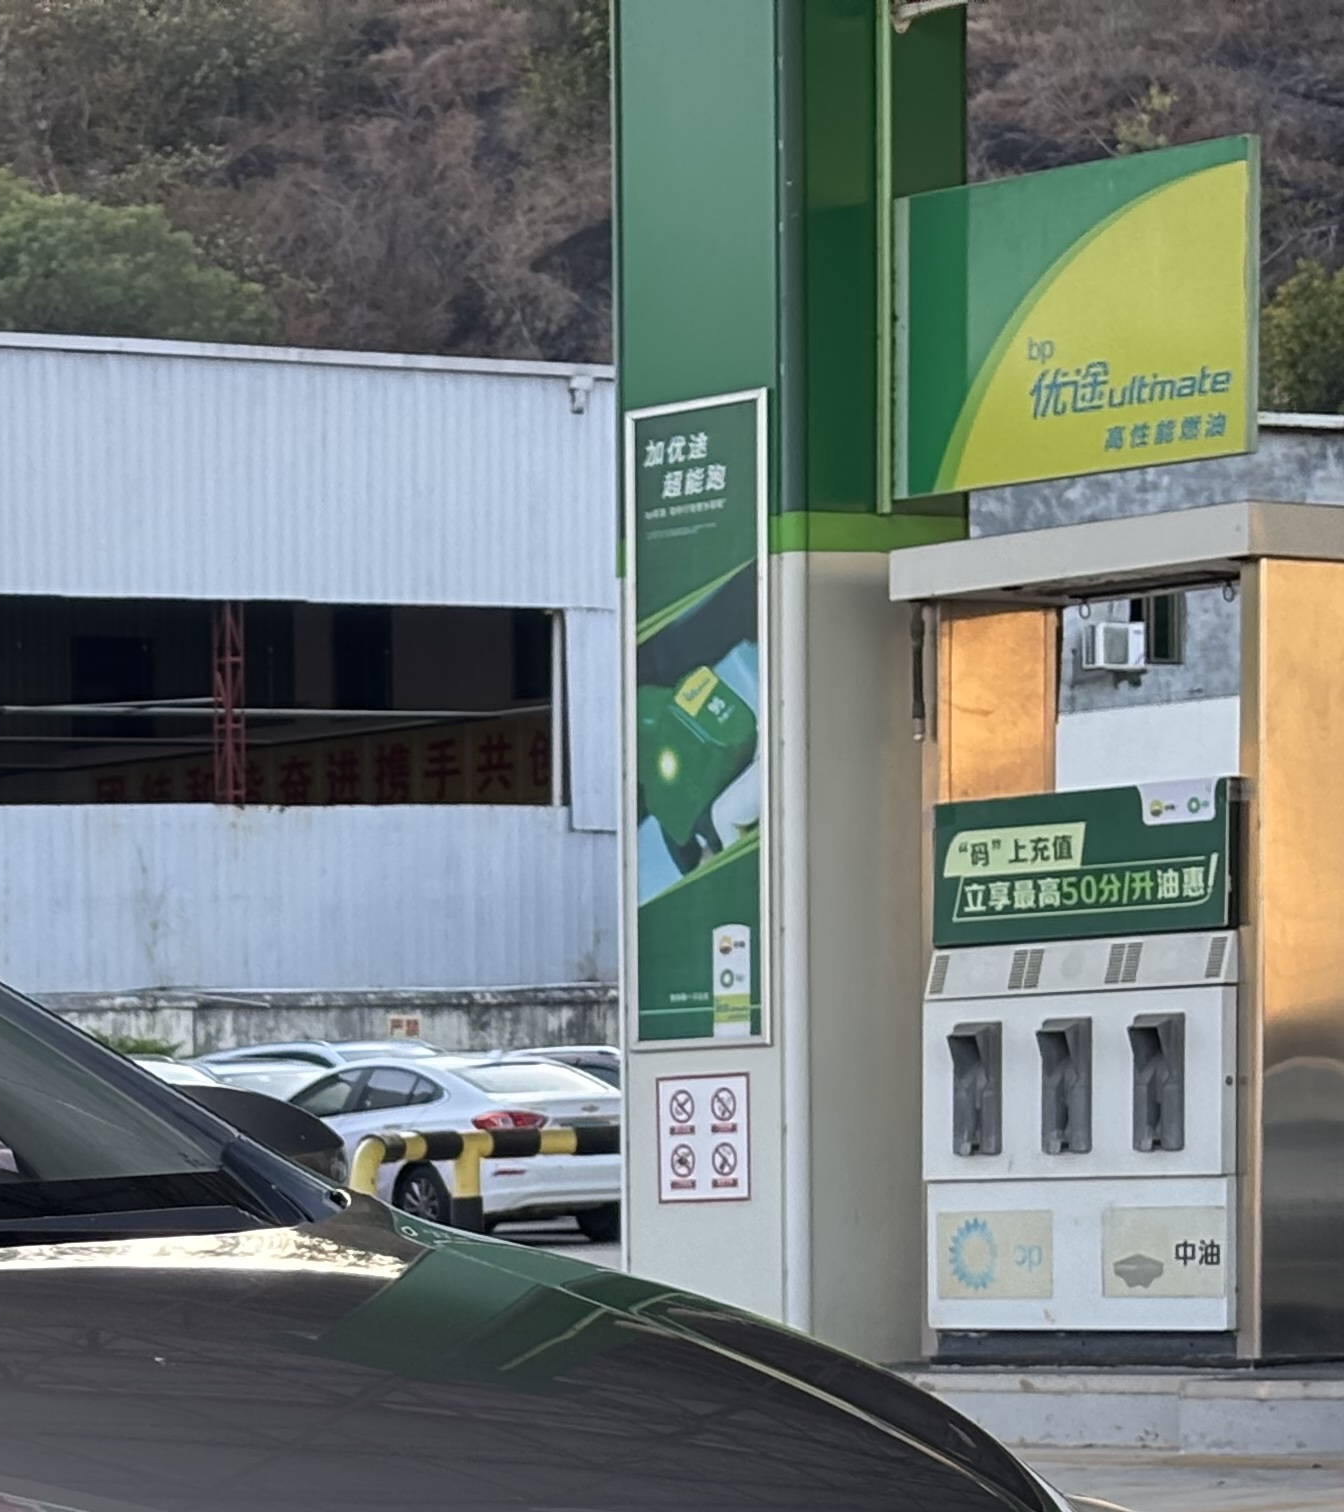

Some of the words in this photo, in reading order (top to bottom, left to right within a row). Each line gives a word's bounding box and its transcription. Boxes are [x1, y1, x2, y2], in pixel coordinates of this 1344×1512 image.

[1028, 338, 1055, 364] bp
[1030, 360, 1109, 419] 优途
[1108, 366, 1232, 408] ultimate
[1105, 411, 1227, 452] 高性能燃油
[1174, 1238, 1221, 1267] 中油
